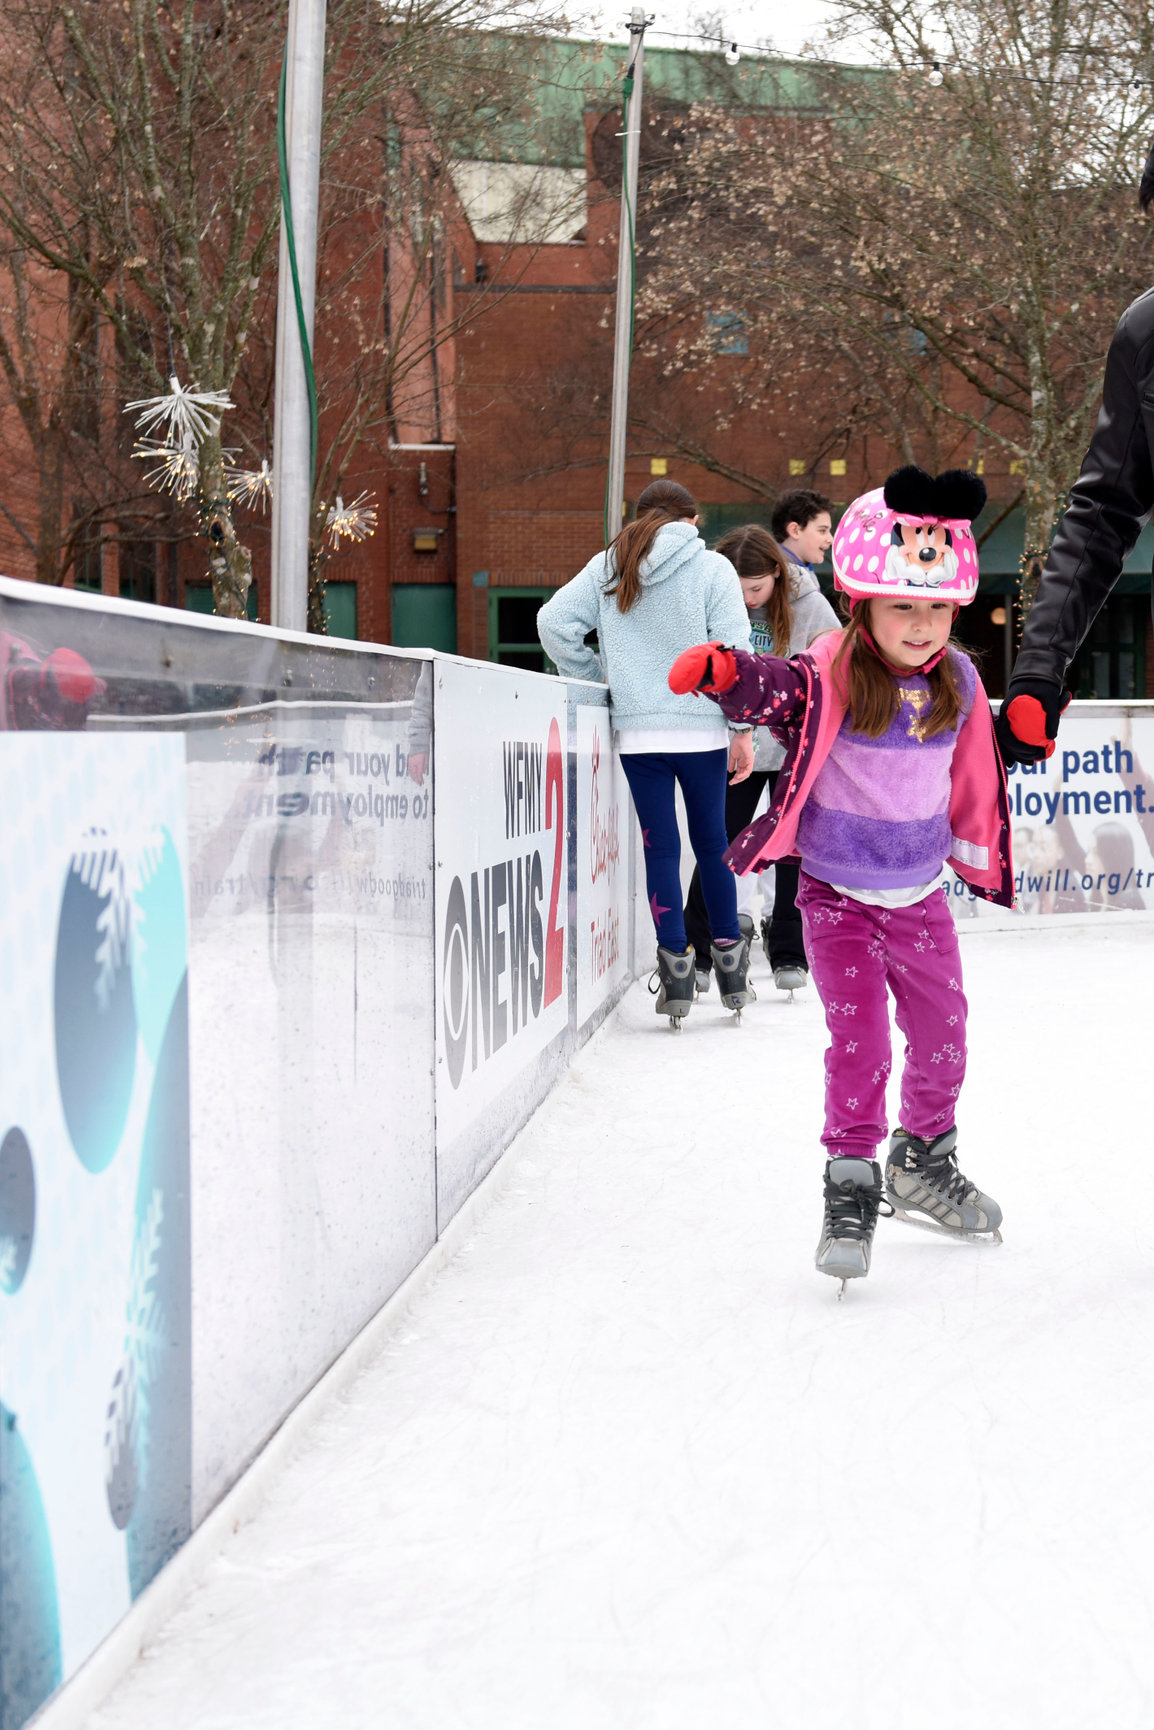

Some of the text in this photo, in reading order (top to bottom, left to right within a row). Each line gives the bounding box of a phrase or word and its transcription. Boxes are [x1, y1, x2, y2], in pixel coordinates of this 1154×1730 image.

[754, 634, 773, 647] CITY
[502, 740, 543, 840] WFMY
[1062, 740, 1134, 783] path
[544, 716, 564, 1010] 2
[470, 848, 545, 1073] NEWS
